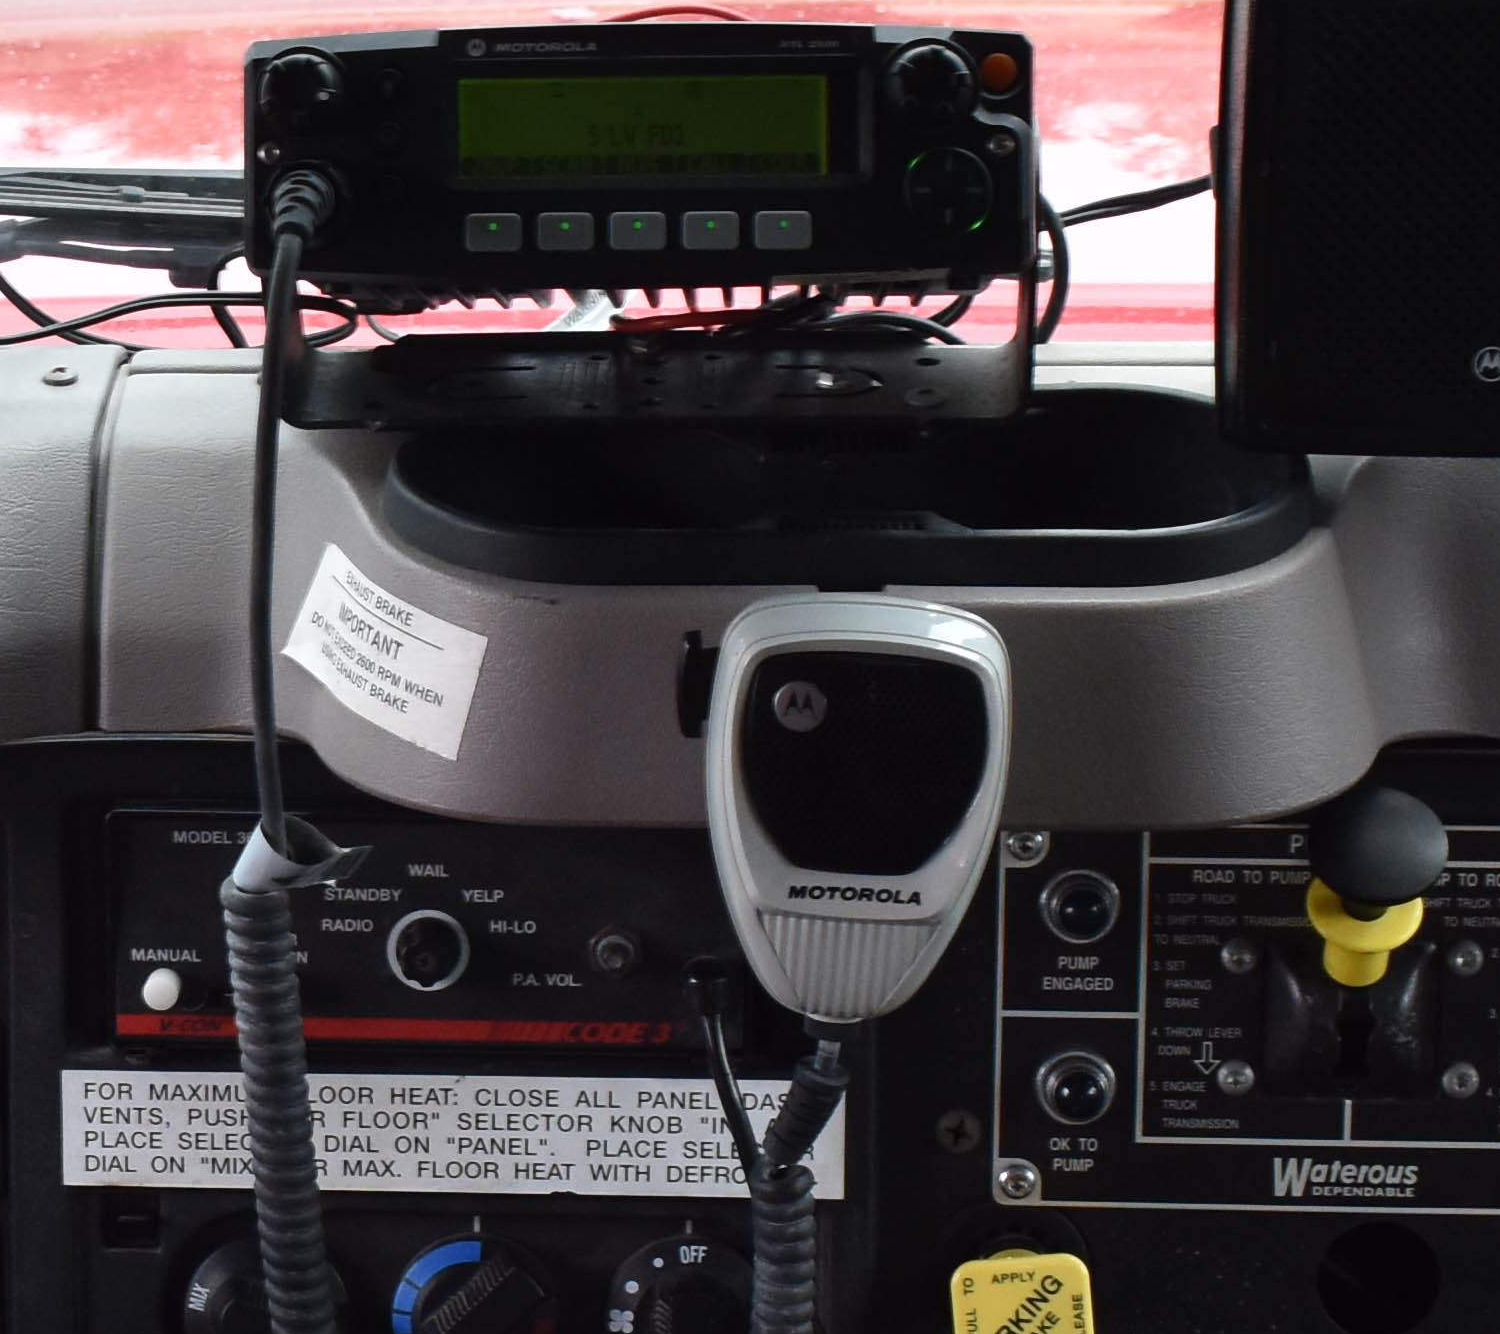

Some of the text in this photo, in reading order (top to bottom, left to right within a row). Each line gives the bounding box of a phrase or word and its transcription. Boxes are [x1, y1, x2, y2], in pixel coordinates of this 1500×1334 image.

[495, 42, 598, 53] MOTOROLA
[375, 595, 414, 627] BRAKE
[338, 602, 404, 660] IMPORTANT
[377, 666, 402, 688] RPM
[405, 679, 444, 708] WHEN
[370, 683, 409, 714] BRAKE
[173, 831, 232, 845] MODEL
[408, 864, 448, 878] WAIL
[1192, 869, 1312, 884] ROAD TO PUMP
[1458, 874, 1478, 886] TO
[324, 888, 401, 902] STANDBY
[462, 889, 504, 903] YELP
[788, 884, 922, 906] MOTOROLA
[321, 919, 374, 932] RADIO
[490, 920, 536, 934] HI-LO
[131, 949, 201, 963] MANUAL
[1057, 956, 1100, 970] PUMP
[1043, 976, 1114, 991] ENGAGED
[83, 1082, 717, 1110] FOR MAXIMU HEAT: CLOSE ALL PANEL
[83, 1107, 171, 1128] VENTS,
[343, 1110, 440, 1129] FLOOR"
[457, 1113, 593, 1132] SELECTOR
[611, 1115, 683, 1134] KNOB
[84, 1131, 667, 1158] PLACE SELEC DIAL ON "PANEL". PLACE
[1050, 1137, 1098, 1151] OK TO
[83, 1155, 137, 1173] DIAL
[151, 1156, 185, 1173] ON
[201, 1157, 253, 1174] "MIX
[343, 1160, 402, 1178] MAX.
[418, 1161, 500, 1179] FLOOR
[514, 1163, 576, 1181] HEAT
[590, 1165, 650, 1182] WITH
[1053, 1158, 1095, 1172] PUMP
[1273, 1157, 1419, 1197] Waterous
[1312, 1186, 1416, 1197] DEPENDABLE
[679, 1245, 708, 1265] OFF
[991, 1271, 1036, 1284] APPLY
[963, 1277, 974, 1296] TO
[188, 1282, 210, 1313] MIX
